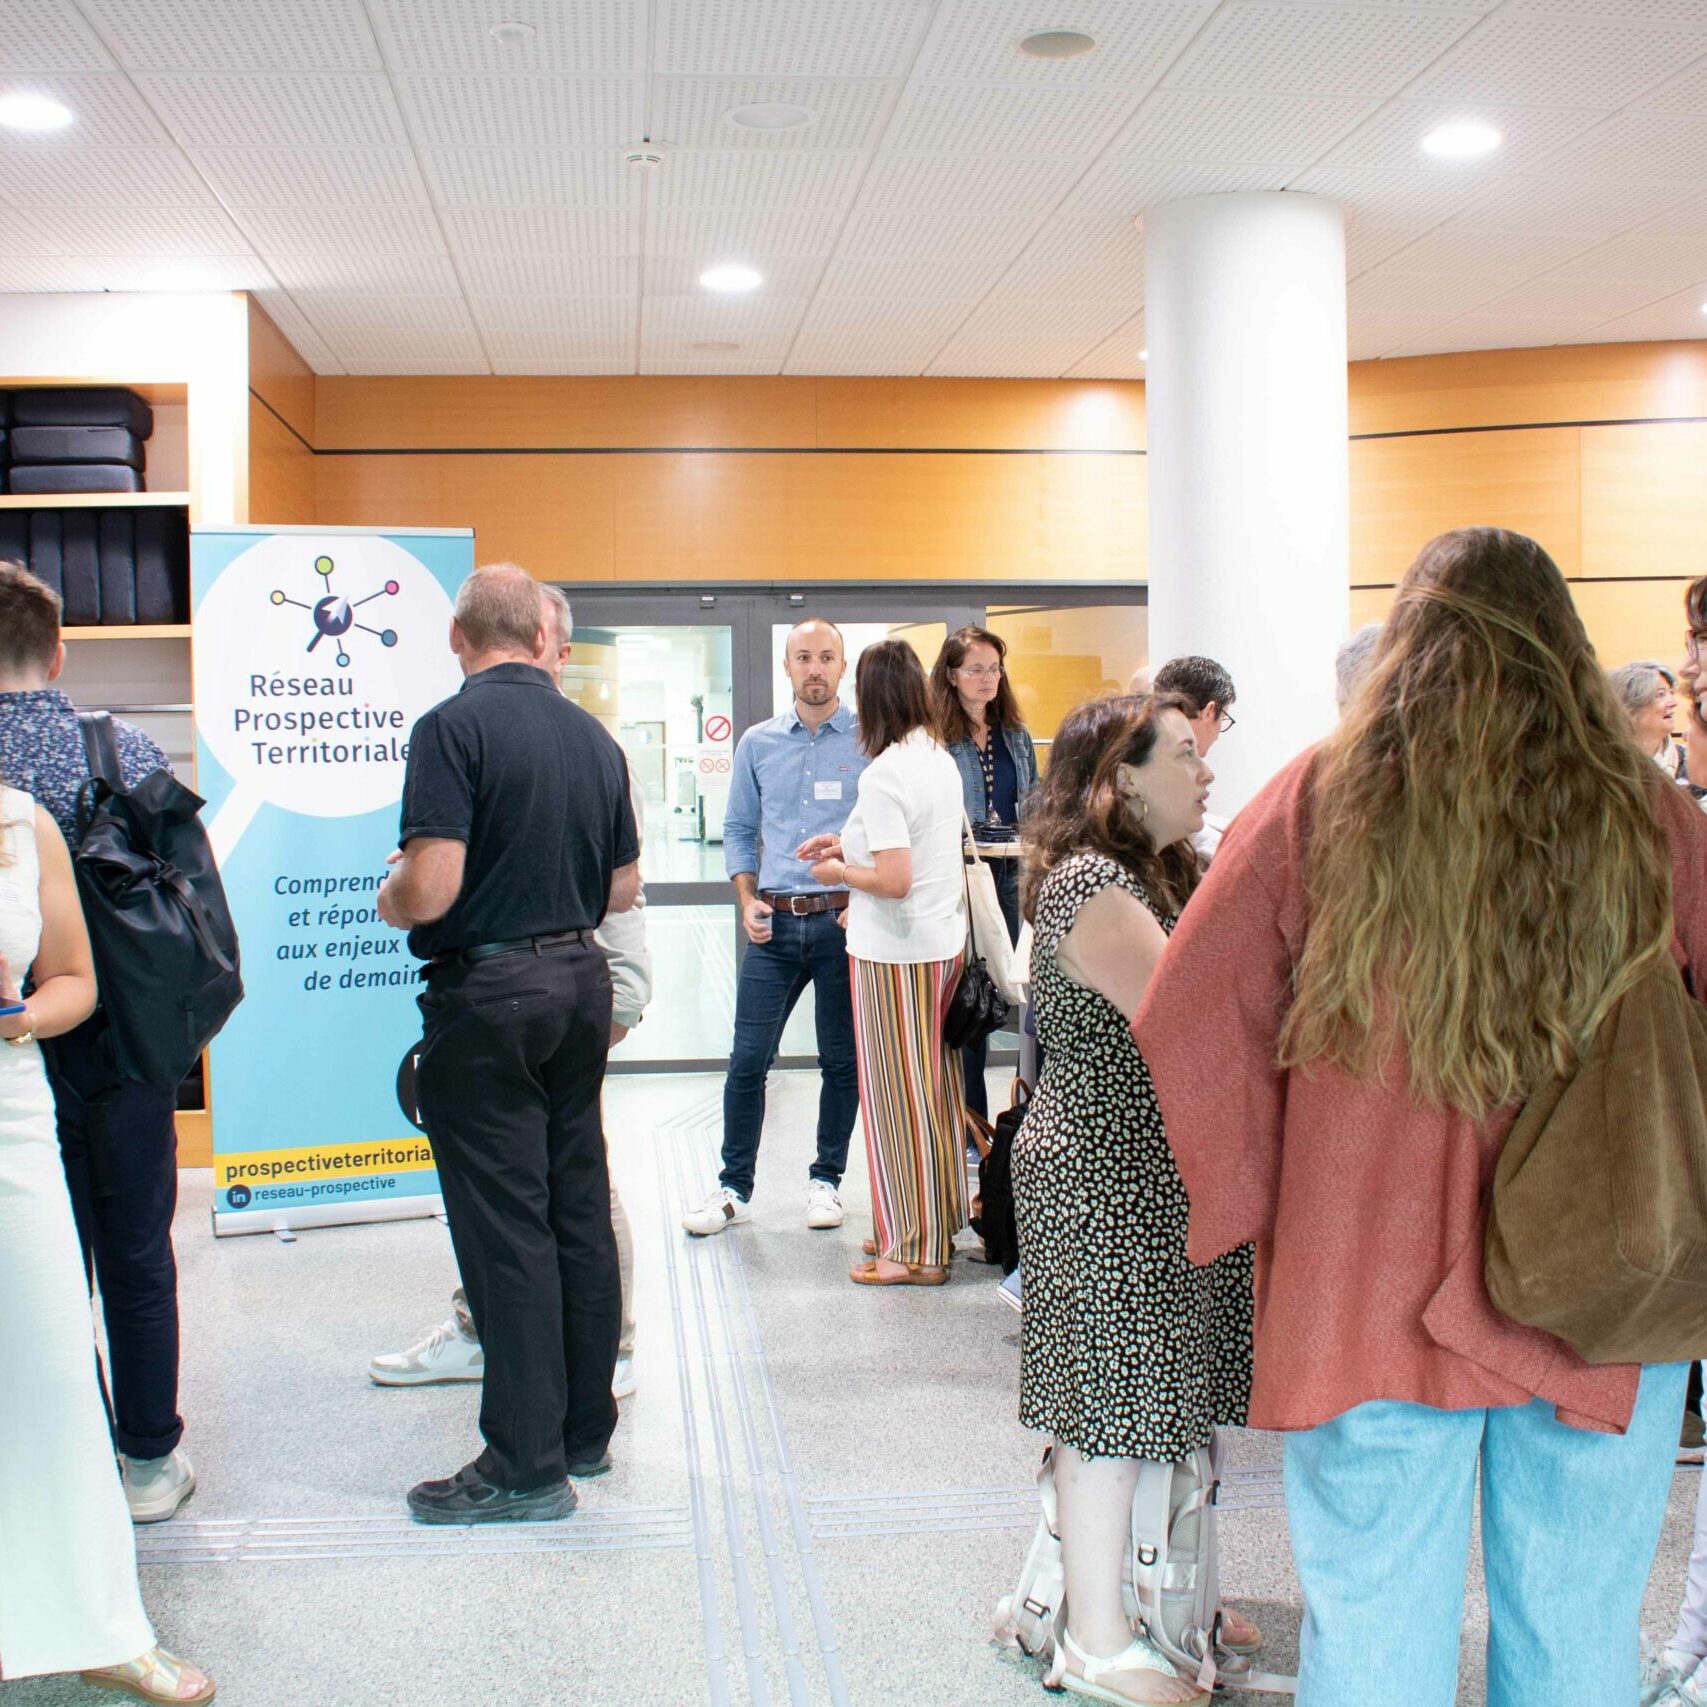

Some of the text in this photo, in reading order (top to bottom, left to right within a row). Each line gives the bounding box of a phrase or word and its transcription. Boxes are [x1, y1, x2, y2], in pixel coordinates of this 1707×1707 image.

[250, 670, 353, 697] Réseau
[234, 702, 404, 736] Prospective
[251, 736, 409, 765] Territoriale
[288, 908, 311, 927] et
[276, 935, 400, 961] aux enjeux
[304, 964, 422, 990] de demain
[226, 1145, 434, 1182] prospectiveterritoria
[255, 1176, 396, 1201] reseau-prospective
